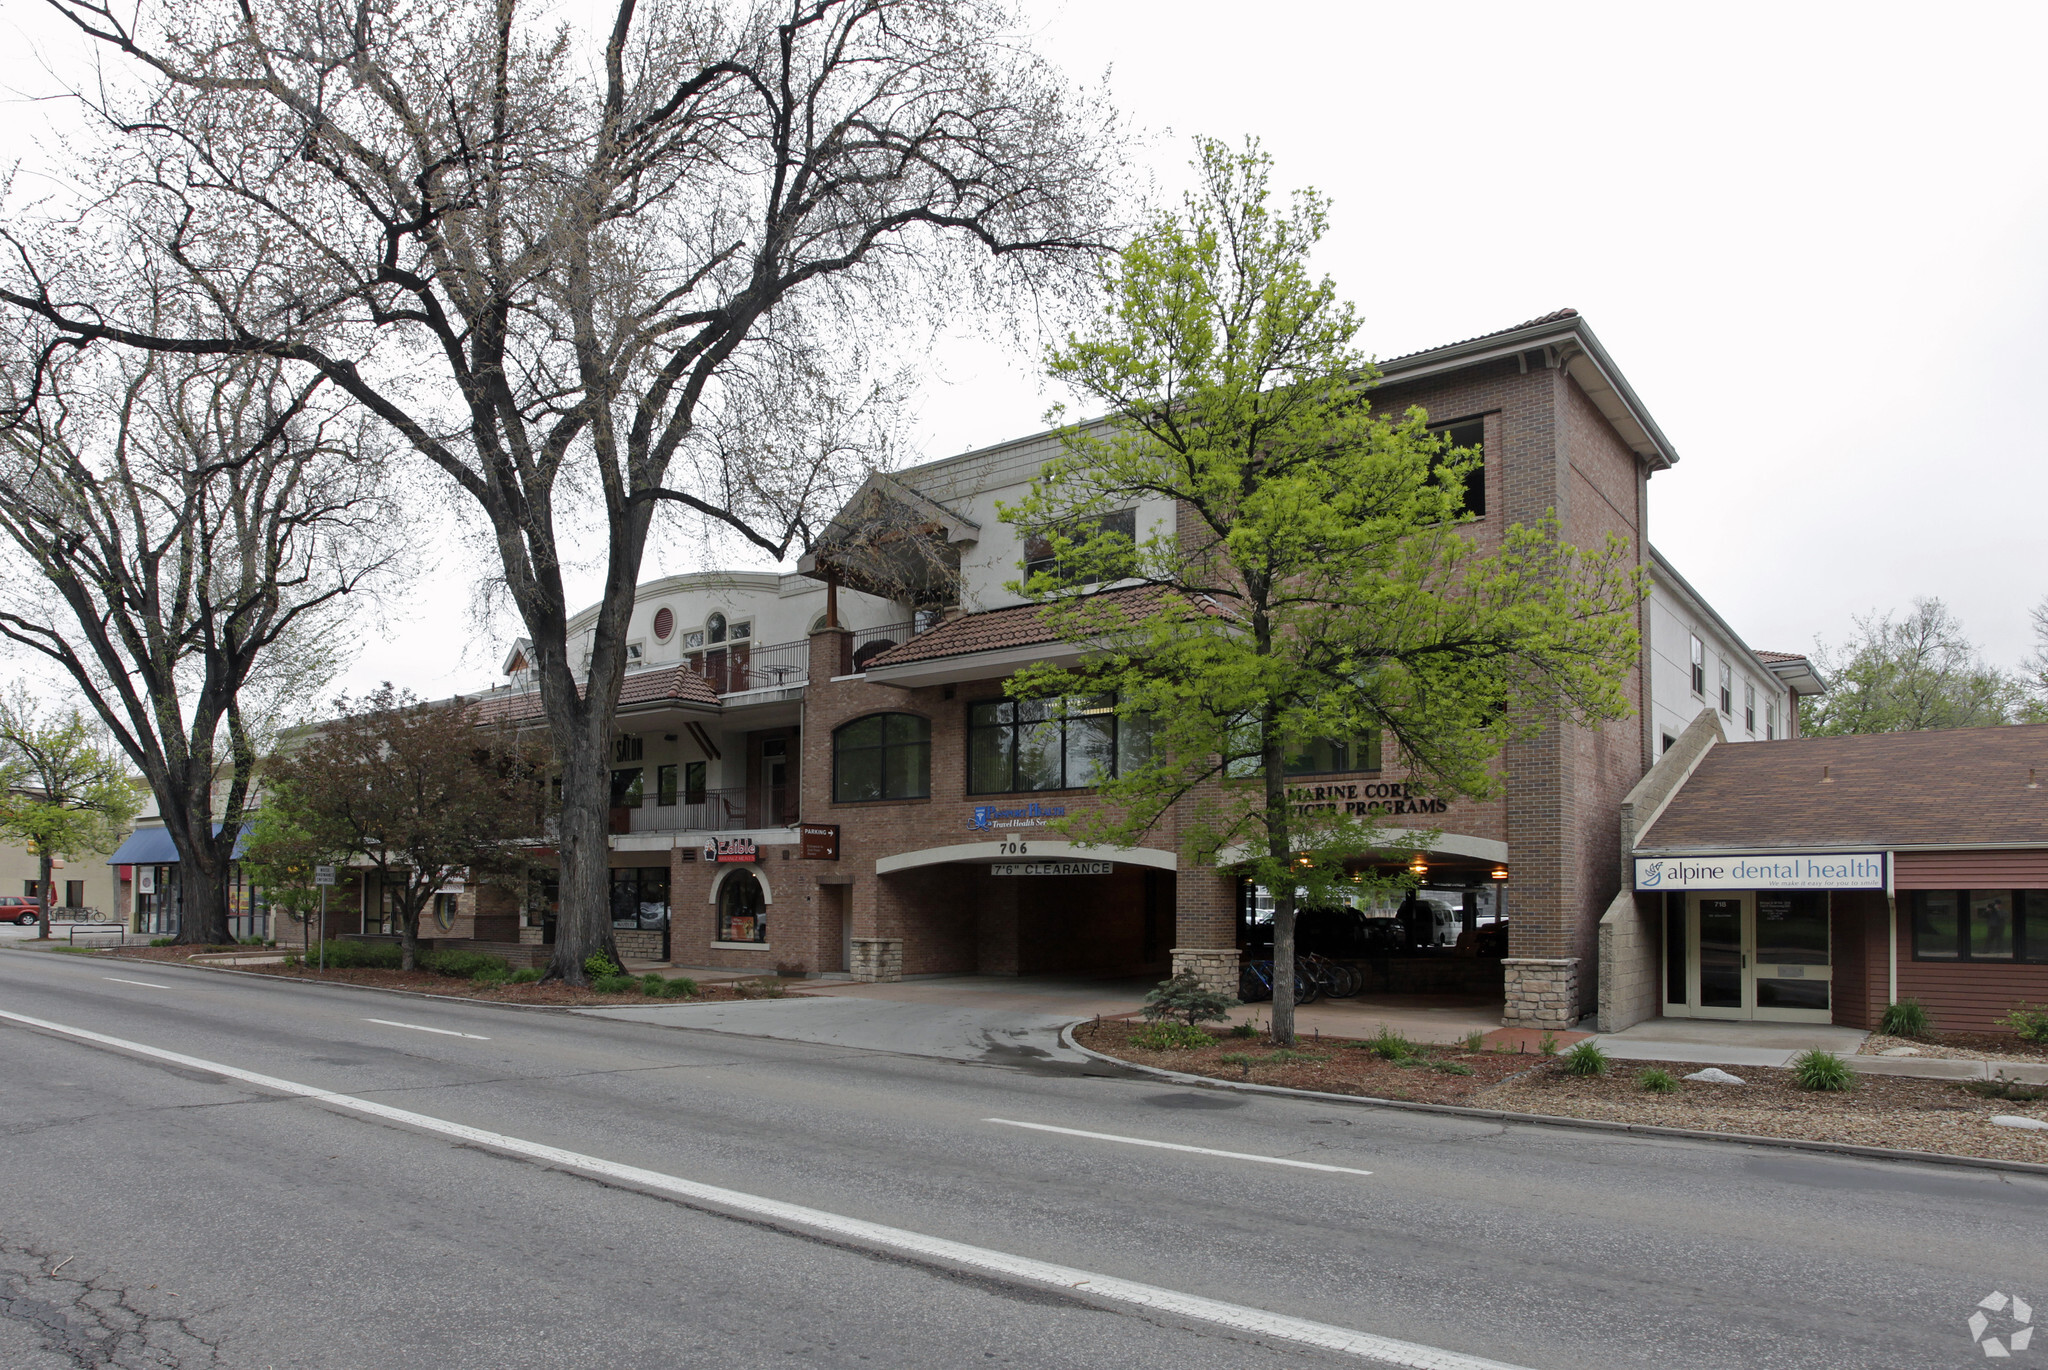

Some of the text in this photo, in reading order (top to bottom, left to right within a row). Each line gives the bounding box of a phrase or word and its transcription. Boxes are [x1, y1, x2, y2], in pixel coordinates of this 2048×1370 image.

[616, 735, 643, 763] SALON
[1286, 785, 1359, 802] MARINE
[1028, 803, 1065, 817] HEALTH
[1344, 798, 1447, 816] PROGRAMS
[992, 820, 1012, 828] Travel
[1013, 818, 1035, 827] Health
[804, 828, 827, 836] PARKING
[718, 838, 756, 855] Edible
[1000, 843, 1027, 855] 706
[995, 863, 1110, 875] 7'6" CLEARANCE
[1667, 858, 1879, 885] alpine dental health
